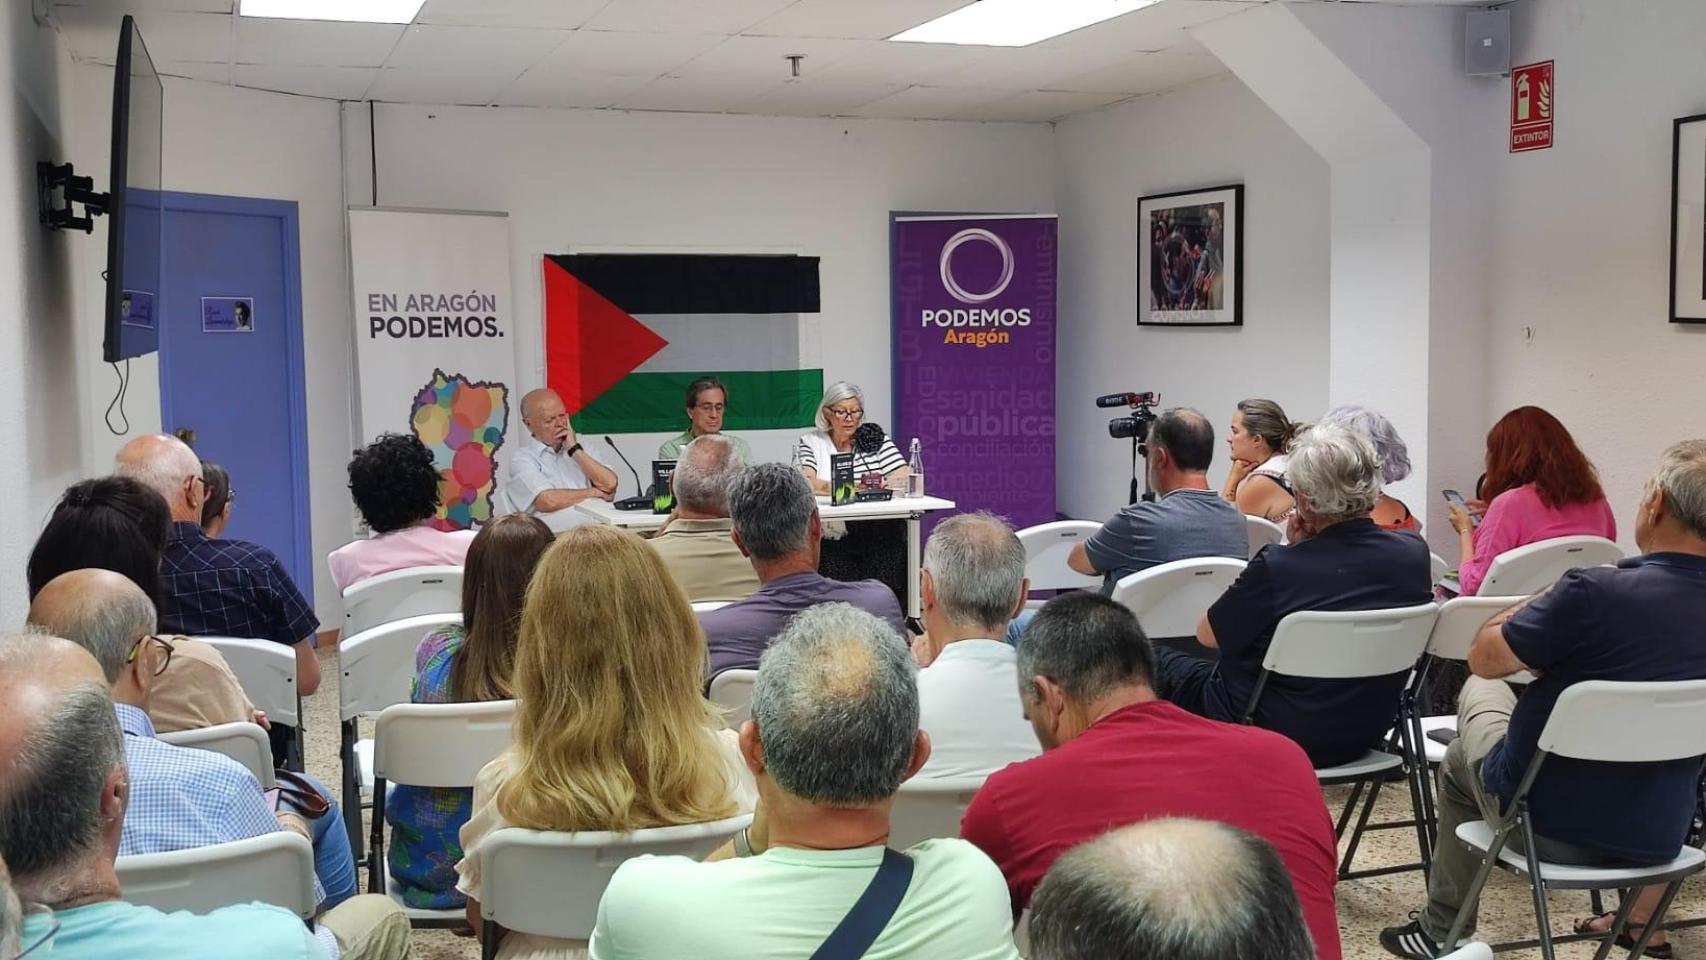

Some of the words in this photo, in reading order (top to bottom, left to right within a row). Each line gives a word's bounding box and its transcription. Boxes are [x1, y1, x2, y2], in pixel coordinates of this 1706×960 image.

[1514, 130, 1549, 144] EXTINTOR
[368, 293, 398, 313] EN
[404, 290, 497, 313] ARAGÓN
[369, 316, 504, 339] PODEMOS.
[921, 308, 1031, 328] PODEMOS
[943, 328, 1009, 348] Aragón
[937, 384, 1054, 409] sanidad
[937, 407, 1056, 442] pública
[937, 438, 1053, 457] conciliación
[941, 465, 1029, 490] medio
